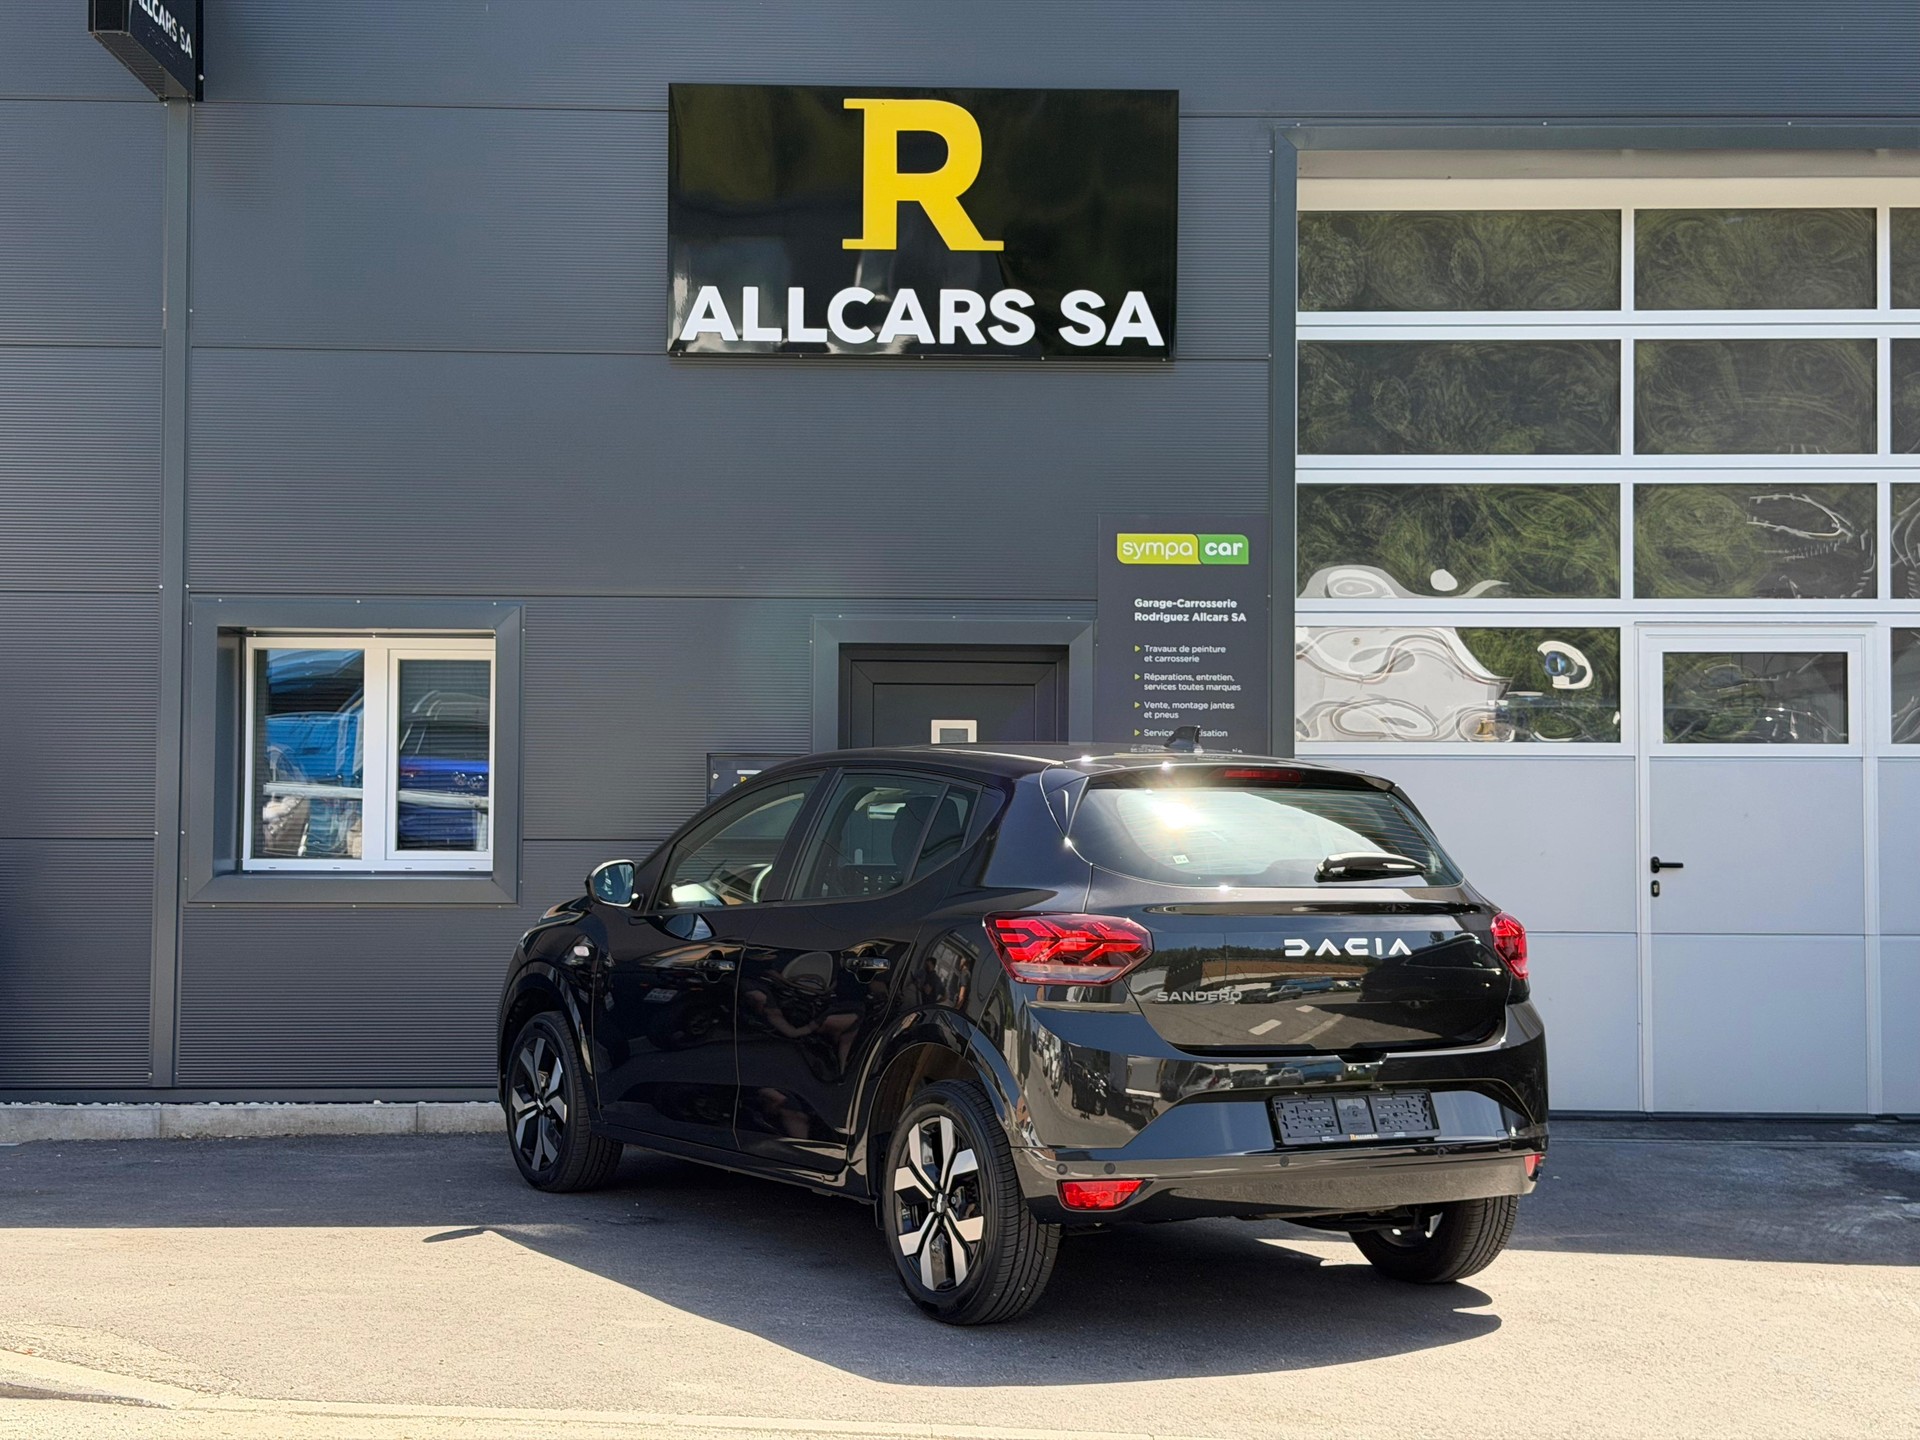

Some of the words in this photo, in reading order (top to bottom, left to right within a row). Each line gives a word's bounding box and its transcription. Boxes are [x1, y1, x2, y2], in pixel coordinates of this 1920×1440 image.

[180, 26, 192, 58] SA
[842, 98, 1004, 250] R
[679, 285, 1036, 346] ALLCARS
[1058, 289, 1165, 347] SA
[1122, 541, 1193, 560] sympa
[1205, 541, 1243, 556] car
[1134, 598, 1238, 609] Garage-Carrosserie
[1134, 612, 1189, 623] Rodriguez
[1192, 612, 1229, 622] Allcars
[1231, 613, 1247, 622] SA
[1144, 645, 1177, 653] Travaux
[1179, 645, 1190, 653] de
[1191, 645, 1226, 655] peinture
[1144, 655, 1153, 663] et
[1154, 655, 1200, 663] carrosserie
[1144, 673, 1195, 682] Réparations,
[1196, 674, 1235, 682] entretien,
[1144, 683, 1177, 691] services
[1206, 684, 1241, 692] marques
[1144, 701, 1170, 709] Vente,
[1172, 702, 1209, 710] montage
[1210, 702, 1235, 710] jantes
[1144, 711, 1153, 719] et
[1154, 712, 1179, 720] pneus
[1284, 937, 1412, 957] DACIA
[1157, 991, 1243, 1002] SANDERO
